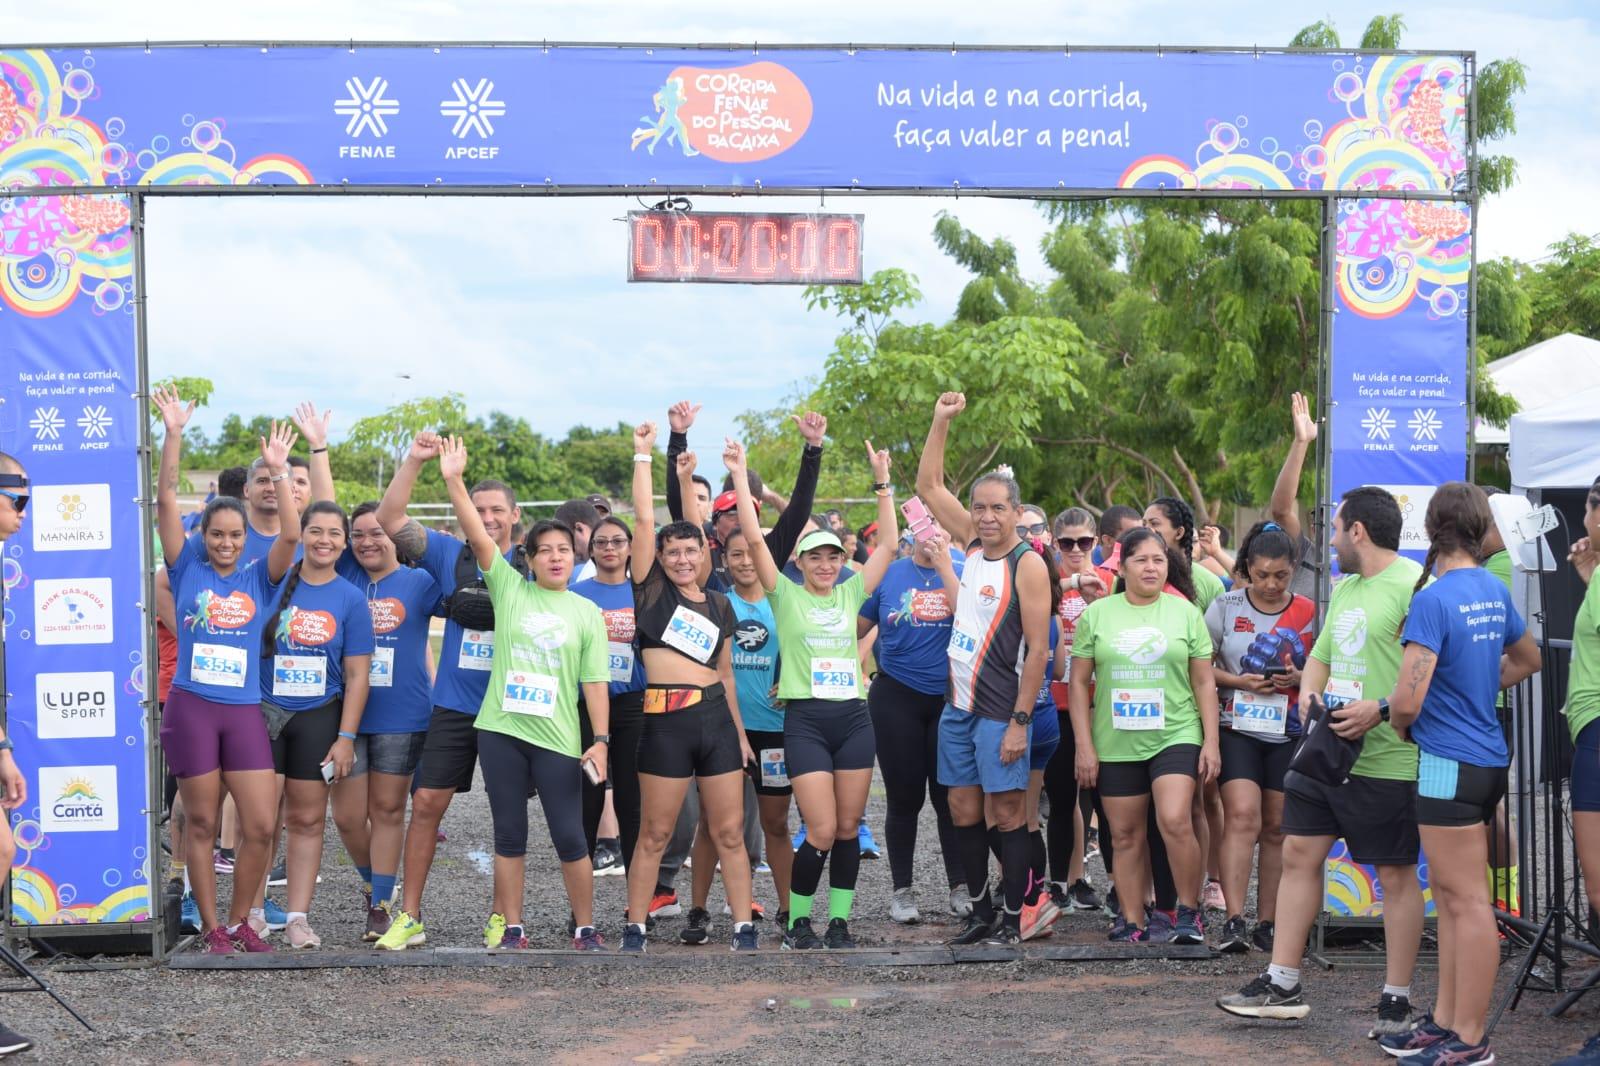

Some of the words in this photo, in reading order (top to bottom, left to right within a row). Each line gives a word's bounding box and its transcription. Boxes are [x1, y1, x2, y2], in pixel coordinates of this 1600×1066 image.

[695, 73, 776, 94] CORRIDA
[877, 82, 912, 107] Na
[920, 80, 975, 109] vida
[984, 88, 998, 107] e
[1007, 88, 1040, 107] na
[1049, 81, 1148, 112] corrida,
[714, 94, 768, 114] FENAE
[692, 116, 716, 129] DO
[720, 111, 792, 133] PESSOAL
[729, 132, 780, 151] CAIXA
[894, 120, 951, 152] faça
[960, 120, 1029, 147] valer
[1036, 129, 1052, 147] a
[1061, 121, 1130, 153] pena!
[339, 146, 396, 158] FENAE
[445, 147, 499, 159] APCEF
[636, 219, 855, 275] 00:00:00
[19, 372, 32, 382] Na
[35, 370, 57, 381] vida
[59, 372, 65, 381] e
[68, 372, 80, 380] na
[83, 370, 121, 380] corrida,
[1352, 372, 1368, 382] Na
[1368, 372, 1389, 383] vida
[1400, 375, 1412, 383] na
[1414, 374, 1452, 384] corrida,
[26, 385, 48, 398] faça
[50, 384, 78, 396] valer
[79, 386, 86, 394] a
[88, 384, 115, 396] pena!
[1358, 386, 1380, 396] faça
[1382, 387, 1408, 397] valer
[1419, 387, 1445, 398] pena!
[32, 444, 64, 452] FENAE
[80, 442, 110, 450] APCEF
[40, 530, 94, 542] MANAÍRA
[98, 531, 104, 540] 3
[680, 623, 708, 646] 258
[203, 658, 236, 672] 355
[284, 670, 316, 683] 335
[822, 673, 849, 685] 239
[44, 691, 105, 710] LUPO
[515, 687, 545, 702] 178
[62, 708, 106, 718] SPORT
[1122, 704, 1152, 716] 171
[1243, 705, 1276, 719] 270
[53, 803, 103, 818] Cantá
[598, 854, 615, 868] FILA
